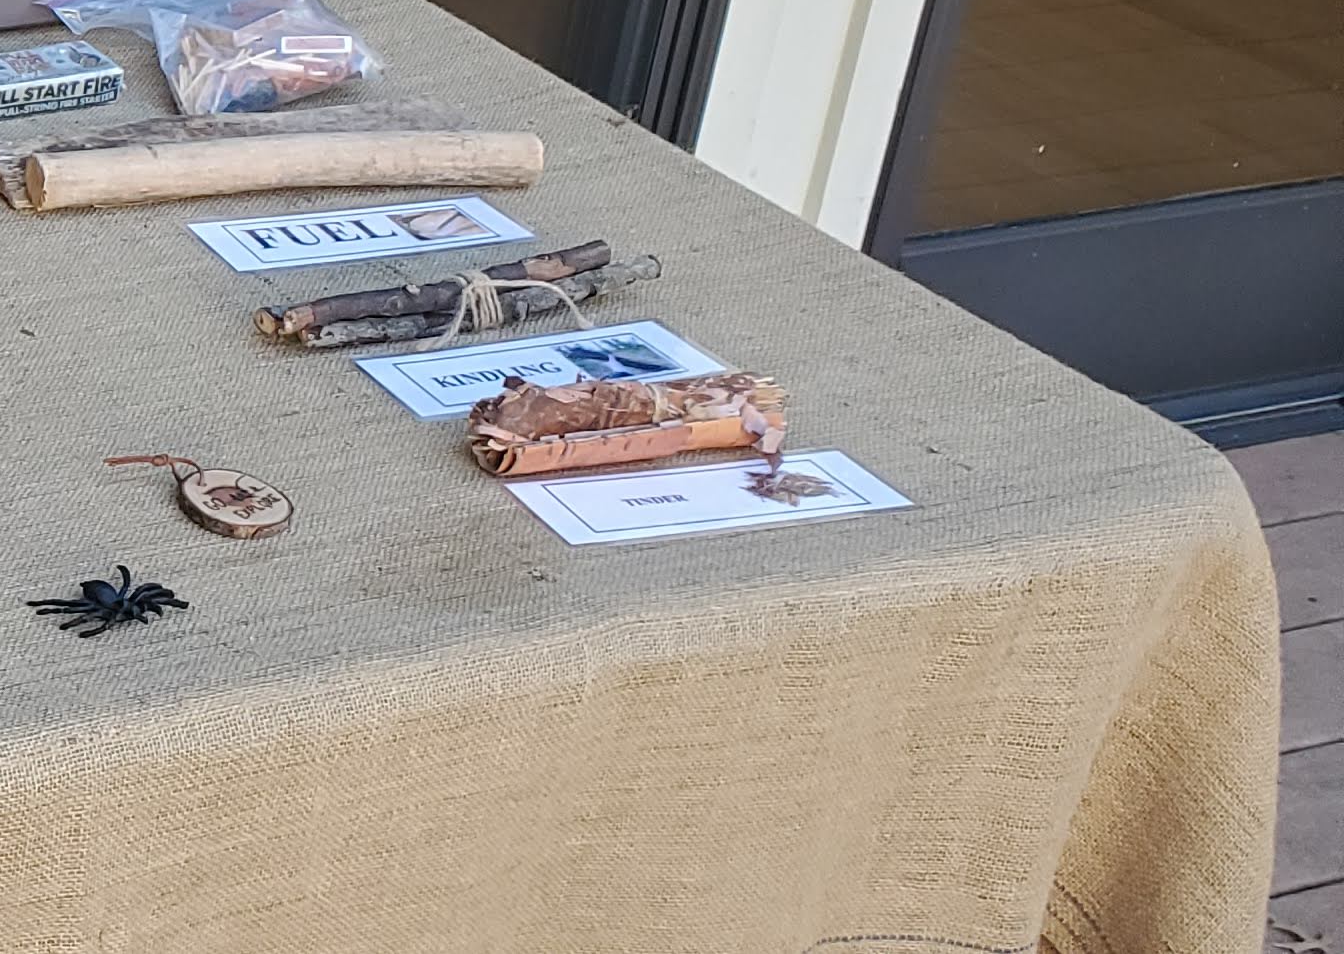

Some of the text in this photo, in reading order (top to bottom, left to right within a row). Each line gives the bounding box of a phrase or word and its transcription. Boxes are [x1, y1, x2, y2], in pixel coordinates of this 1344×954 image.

[23, 81, 80, 102] START
[83, 74, 122, 95] FIRE
[0, 101, 58, 118] PULL-STRING
[60, 98, 78, 109] FIRE
[240, 219, 398, 249] FUEL
[620, 494, 690, 507] TINDER
